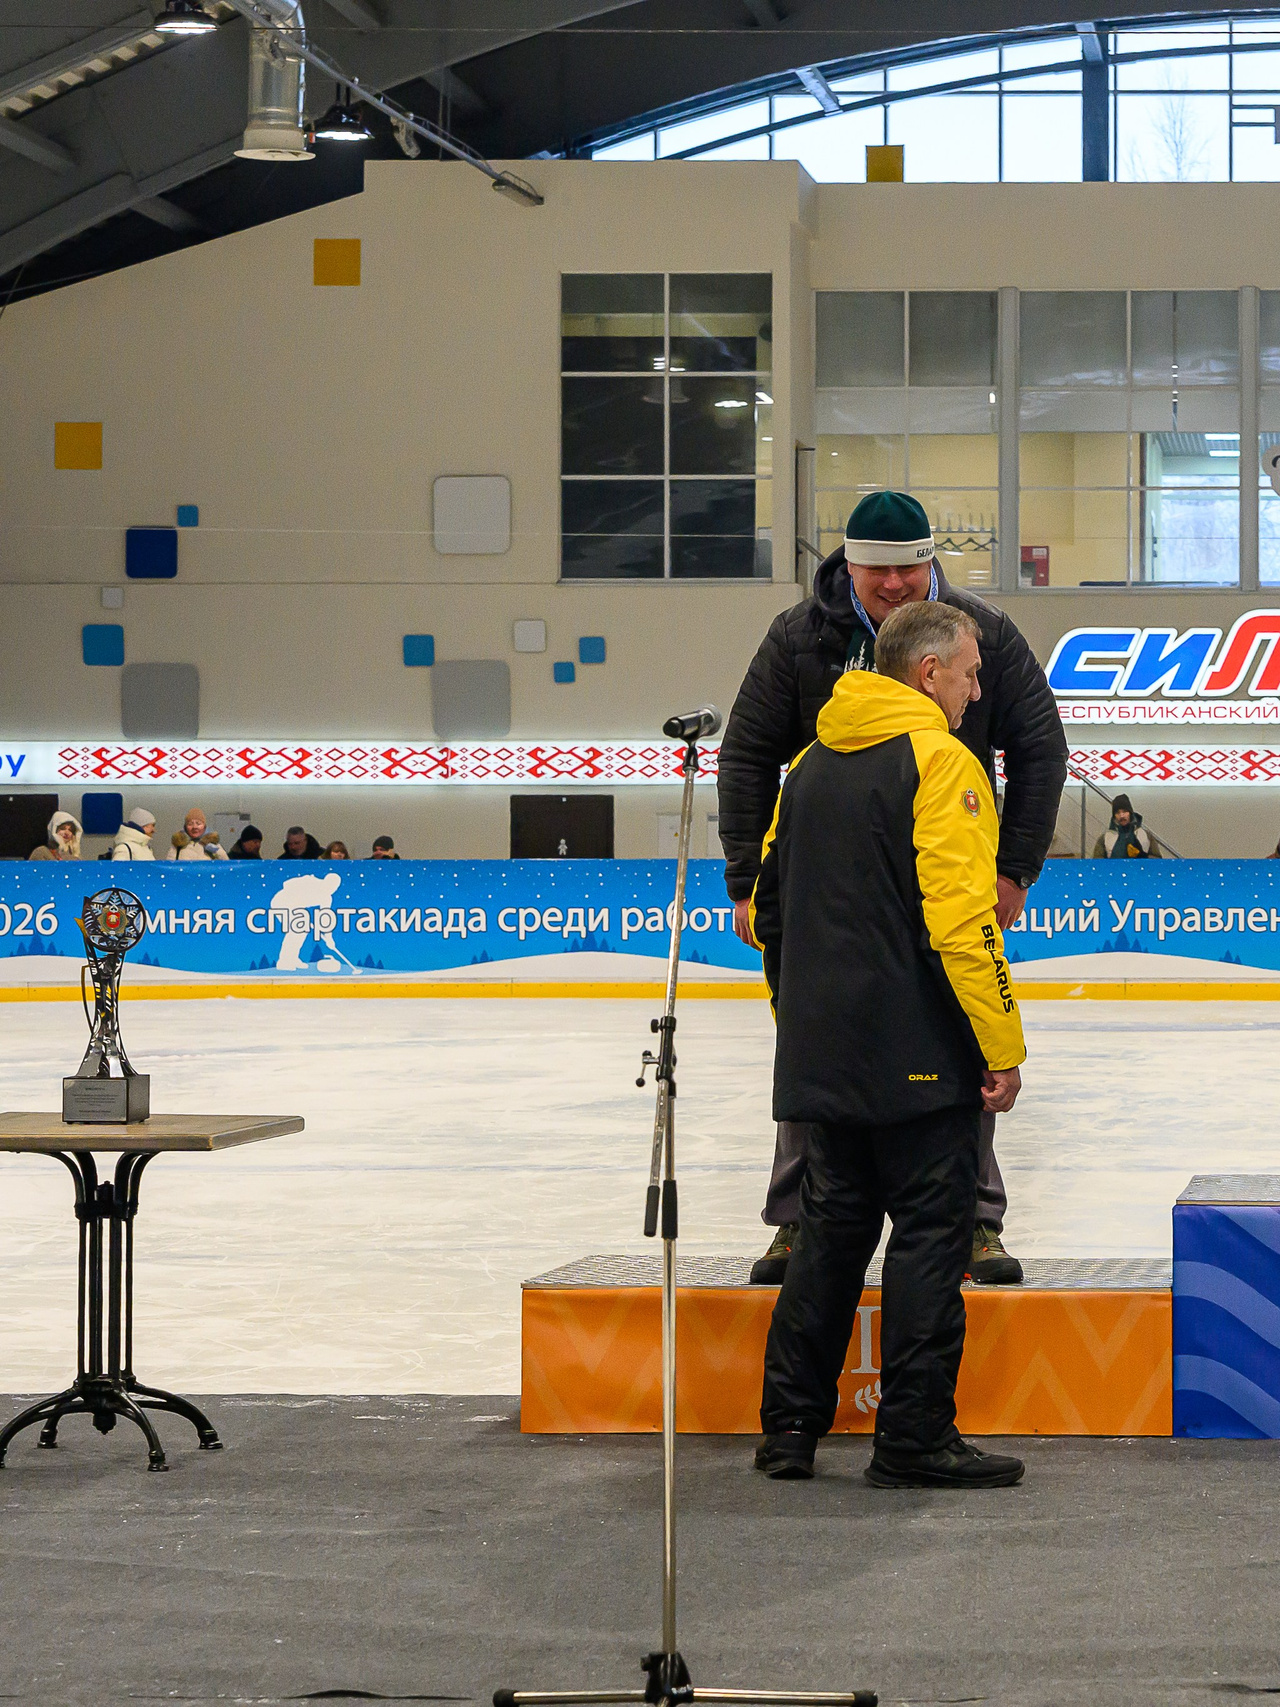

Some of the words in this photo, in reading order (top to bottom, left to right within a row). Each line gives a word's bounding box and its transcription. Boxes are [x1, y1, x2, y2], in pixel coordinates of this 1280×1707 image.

[139, 908, 236, 934] мняя
[246, 907, 487, 939] спартакиада
[496, 907, 610, 940] среди
[621, 895, 736, 940] работ
[980, 923, 1015, 1014] BELARUS
